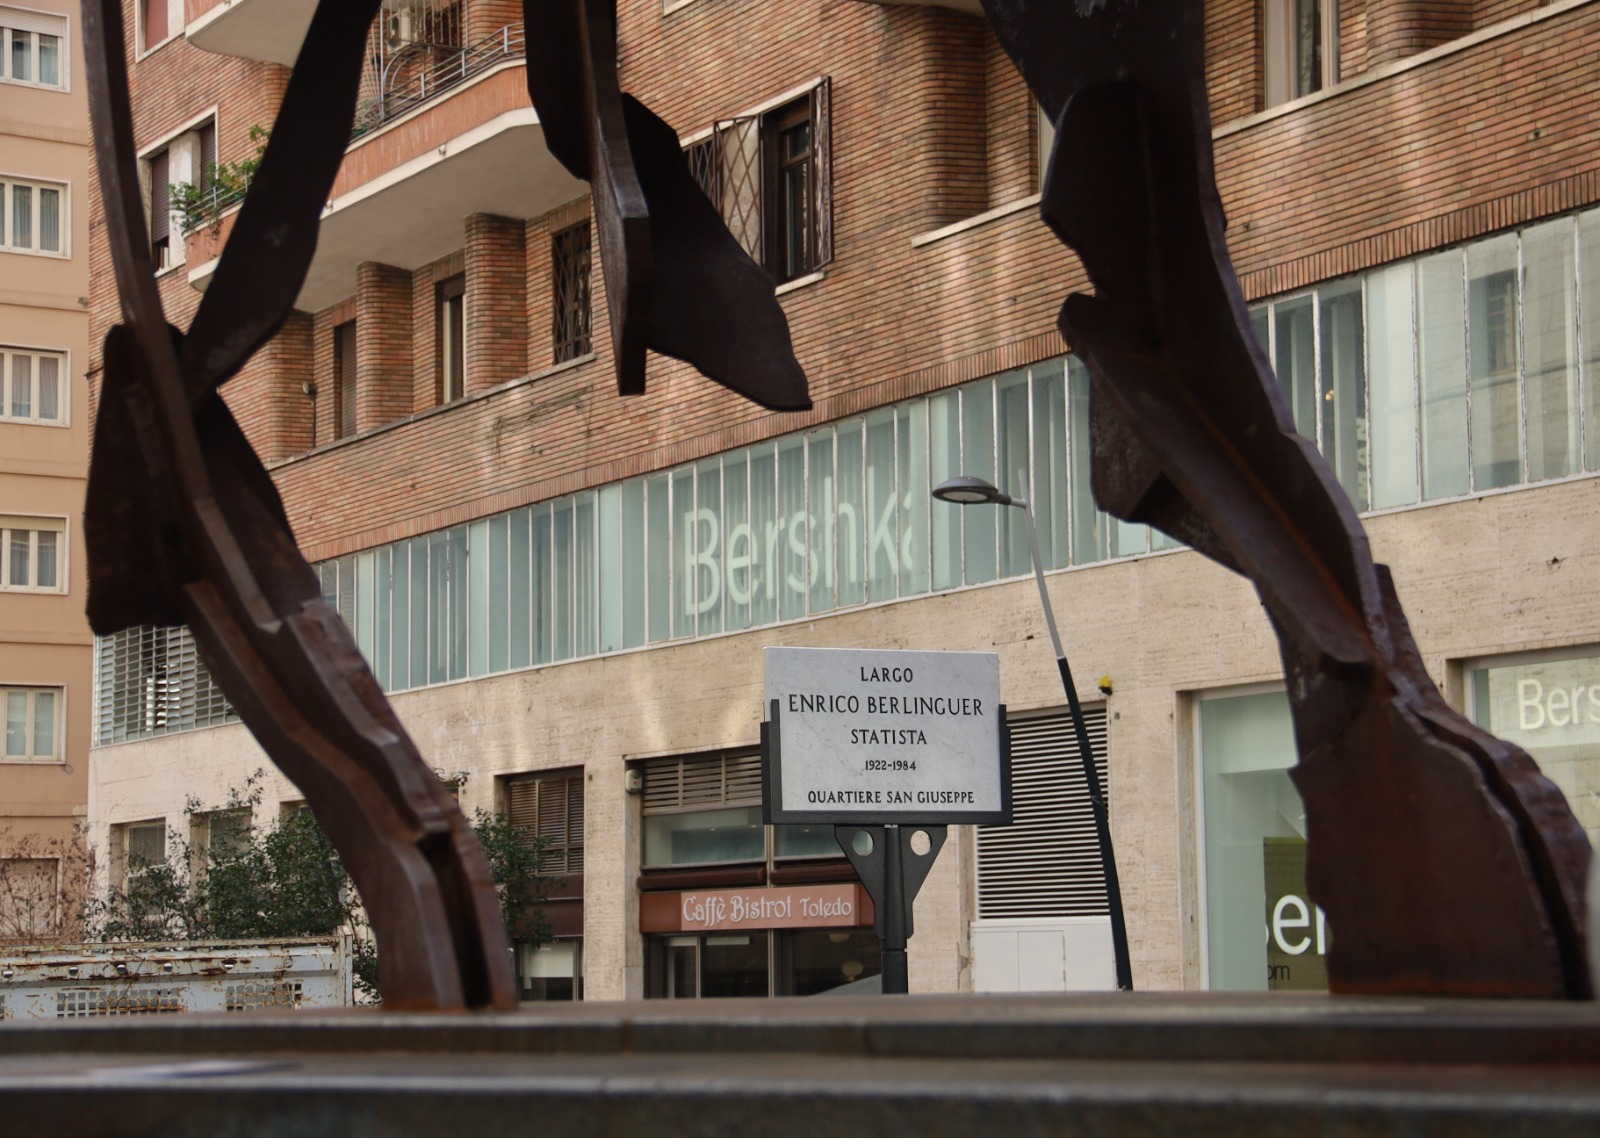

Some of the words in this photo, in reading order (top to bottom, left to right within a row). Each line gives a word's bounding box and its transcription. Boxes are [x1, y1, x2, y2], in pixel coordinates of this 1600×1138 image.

[860, 666, 914, 683] LARGO
[788, 694, 860, 714] ENRICO
[867, 696, 984, 716] BERLINGUER
[850, 729, 928, 745] STATISTA
[864, 760, 917, 771] 1922-1984
[807, 790, 882, 804] QUARTIERE
[886, 791, 913, 804] SAN
[917, 791, 975, 804] GIUSEPPE
[682, 896, 727, 927] Caffè
[730, 894, 793, 923] Bistrot
[799, 896, 852, 919] Toledo
